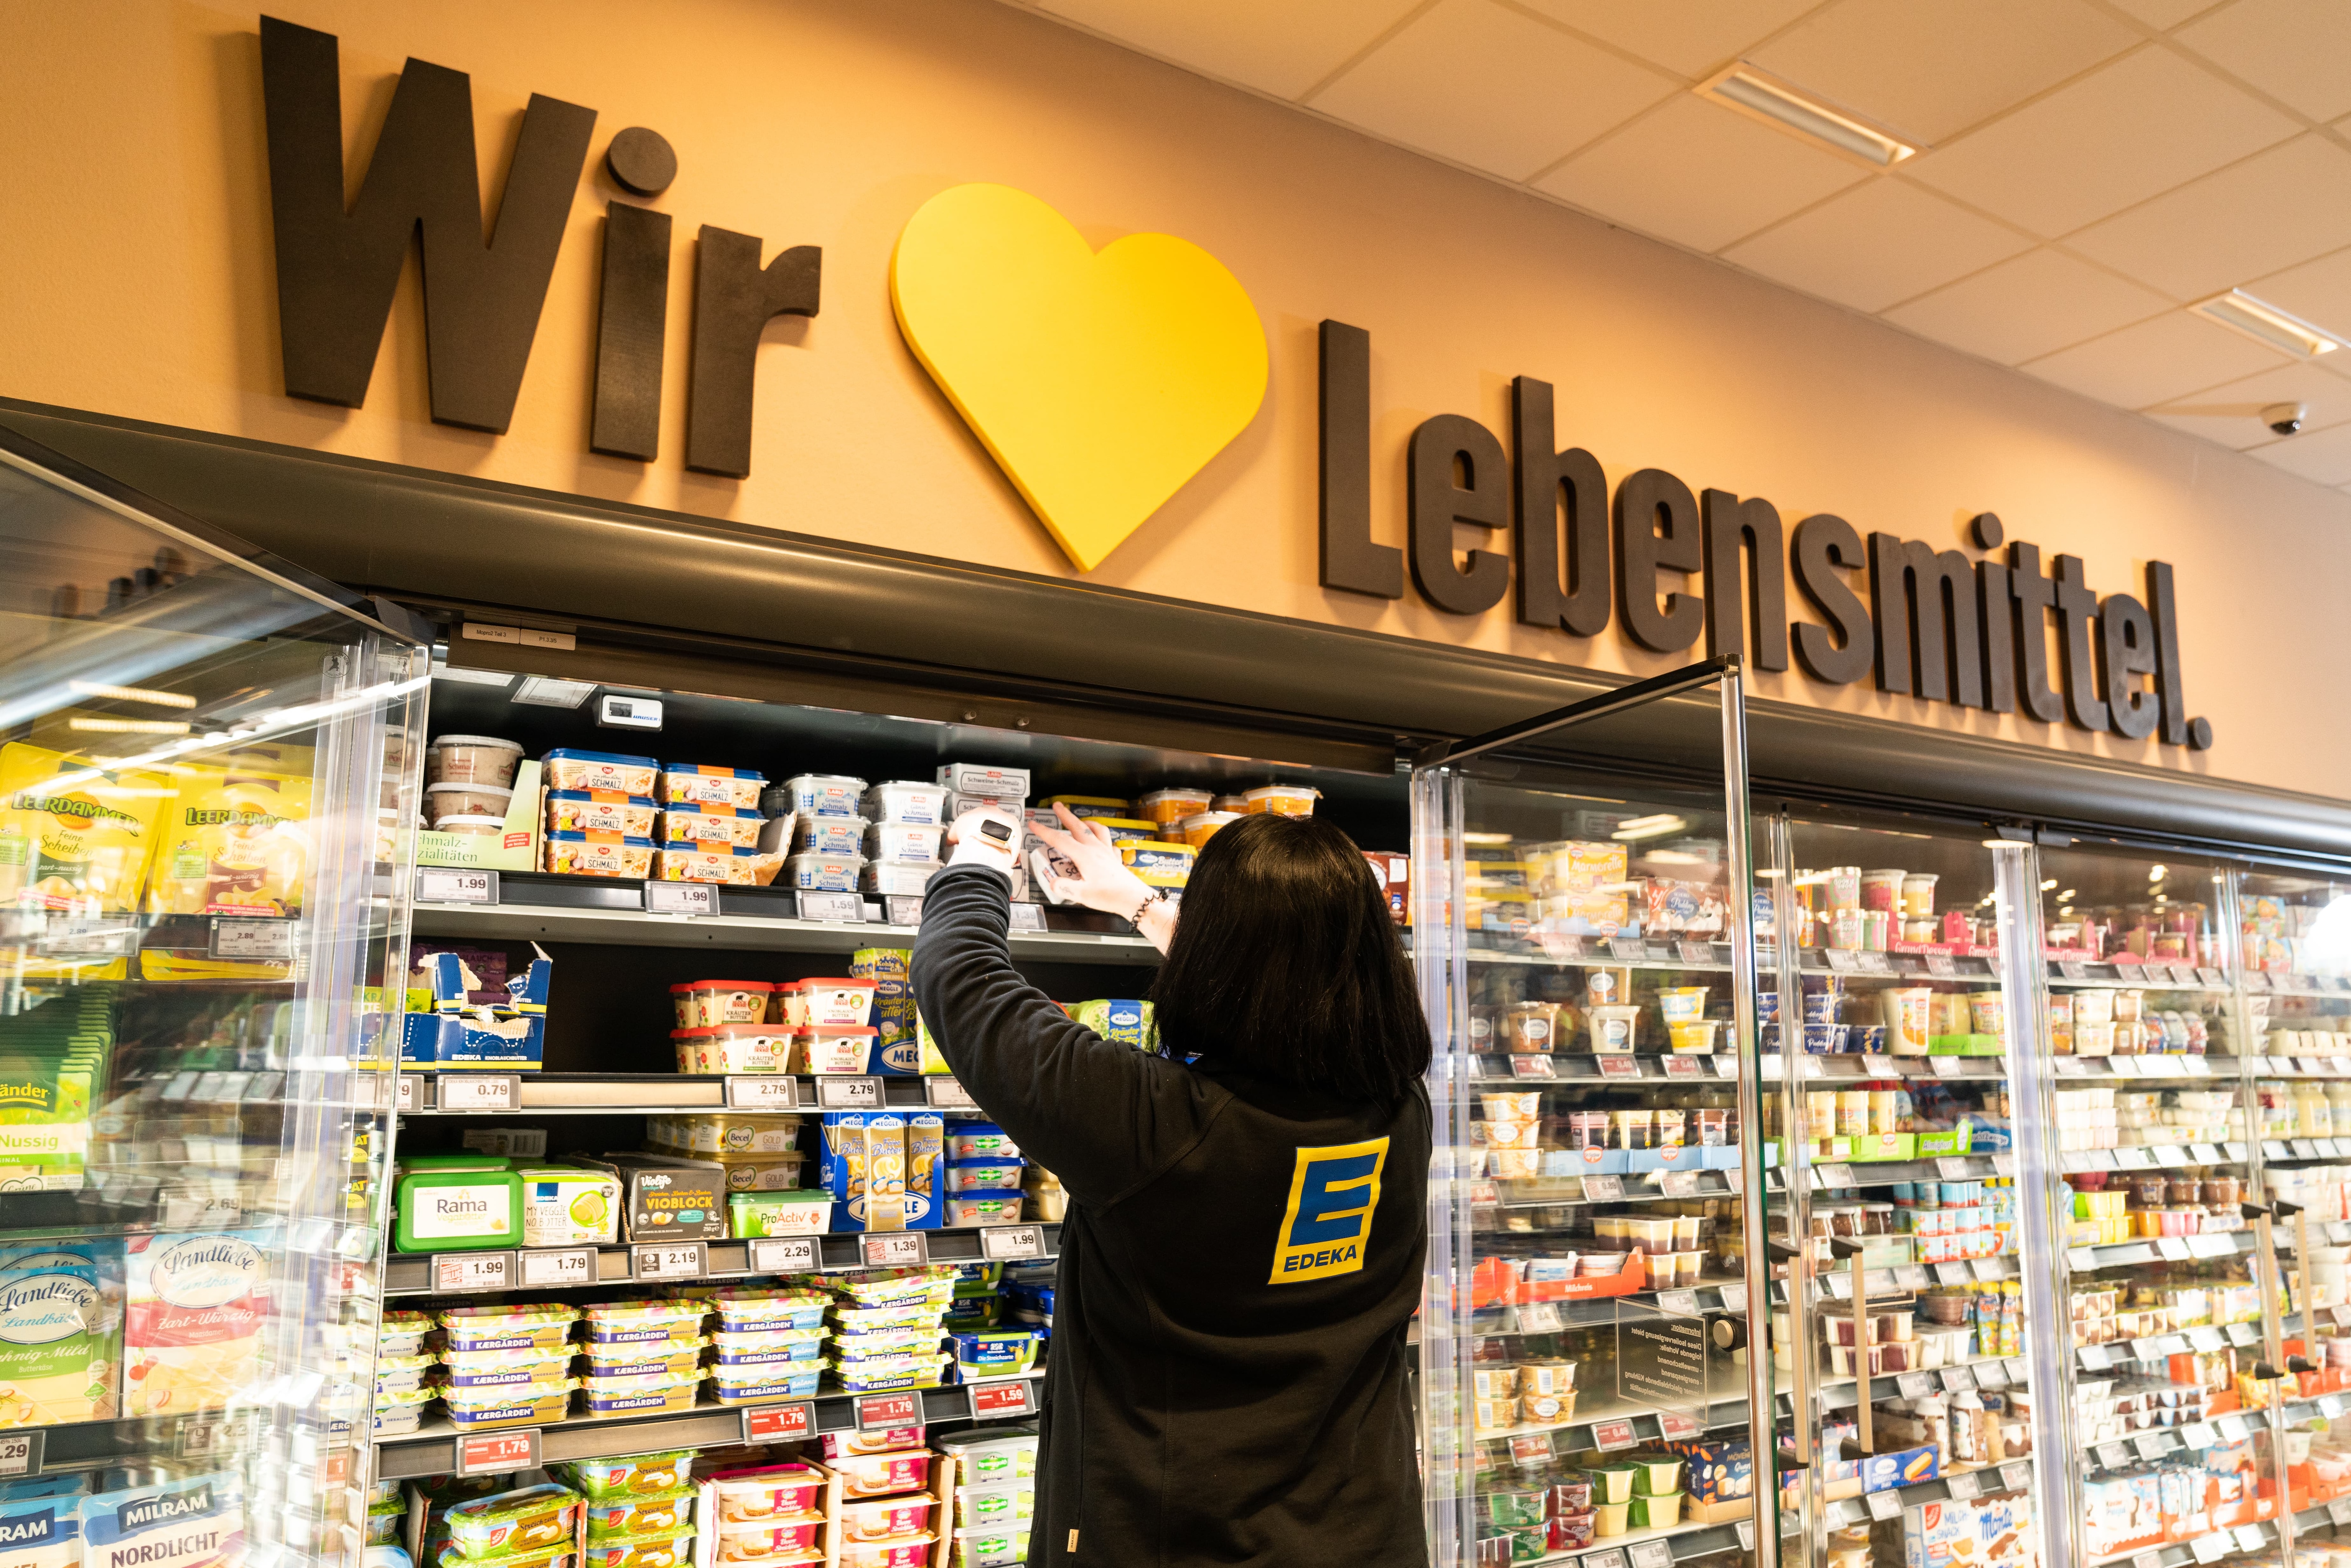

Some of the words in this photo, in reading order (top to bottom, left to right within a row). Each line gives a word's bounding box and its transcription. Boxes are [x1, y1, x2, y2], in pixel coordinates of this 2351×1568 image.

[260, 13, 823, 481] Wir
[1318, 318, 2213, 751] Lebensmittel.
[592, 779, 622, 789] SCHMALZ
[701, 791, 728, 801] SCHMALZ
[12, 790, 139, 837] LEERDAMMER
[590, 818, 620, 829] SCHMALZ
[58, 829, 84, 843] Feine
[700, 829, 728, 840] SCHMALZ
[39, 835, 94, 858] Scheiben
[233, 841, 256, 851] Feine
[213, 846, 268, 865] Scheiben
[38, 864, 83, 875] zart-nussig
[588, 859, 618, 870] SCHMALZ
[1571, 856, 1623, 872] Marmorette
[698, 867, 726, 878] SCHMALZ
[457, 878, 486, 889] 1.99
[682, 891, 707, 901] 1.99
[830, 900, 853, 910] 1.59
[1670, 898, 1694, 912] Pudding
[1110, 1028, 1139, 1039] Kräuter
[478, 1085, 508, 1095] 0.79
[761, 1085, 786, 1095] 2.79
[850, 1085, 874, 1094] 2.79
[730, 1134, 749, 1142] Becel
[763, 1135, 781, 1144] GOLD
[872, 1144, 903, 1157] Butter
[911, 1142, 941, 1153] Butter
[1922, 1140, 1953, 1152] Almighurt
[641, 1175, 672, 1189] Violife
[733, 1174, 752, 1182] Becel
[766, 1174, 784, 1182] GOLD
[437, 1199, 487, 1213] Rama
[646, 1196, 713, 1210] VIOBLOCK
[527, 1206, 536, 1216] MY
[539, 1206, 567, 1215] VEGGIE
[526, 1217, 536, 1227] NO
[761, 1212, 807, 1224] ProActiv
[1012, 1235, 1033, 1245] 1.99
[784, 1246, 810, 1258] 2.29
[892, 1241, 916, 1252] 1.39
[670, 1252, 696, 1264] 2.19
[869, 1247, 885, 1259] BILLIG
[1283, 1245, 1357, 1272] EDEKA
[164, 1243, 255, 1281] Landliebe
[473, 1262, 503, 1274] 1.99
[557, 1258, 585, 1270] 1.79
[442, 1270, 462, 1283] BILLIG
[931, 1285, 947, 1295] Bio
[1565, 1284, 1593, 1293] Milchreis
[0, 1282, 93, 1312] Landliebe
[158, 1309, 255, 1330] Zart-Würzig
[189, 1328, 225, 1338] Maasdamer
[916, 1342, 932, 1351] Bio
[18, 1363, 54, 1373] Butterkäse
[919, 1368, 935, 1377] Bio
[1000, 1389, 1023, 1401] 1.59
[888, 1402, 913, 1413] 1.79
[779, 1413, 805, 1425] 1.79
[498, 1441, 529, 1455] 1.79
[638, 1463, 675, 1475] Streichzart
[895, 1471, 911, 1479] Unsere
[126, 1493, 209, 1527] MILRAM
[637, 1503, 675, 1516] Streichzart
[520, 1515, 558, 1532] Streichzart
[1944, 1511, 1970, 1525] MILCH-
[1979, 1507, 2013, 1541] Monte
[1937, 1528, 1961, 1539] SNACK
[111, 1531, 220, 1568] NORDLICHT
[635, 1543, 673, 1555] Streichzart
